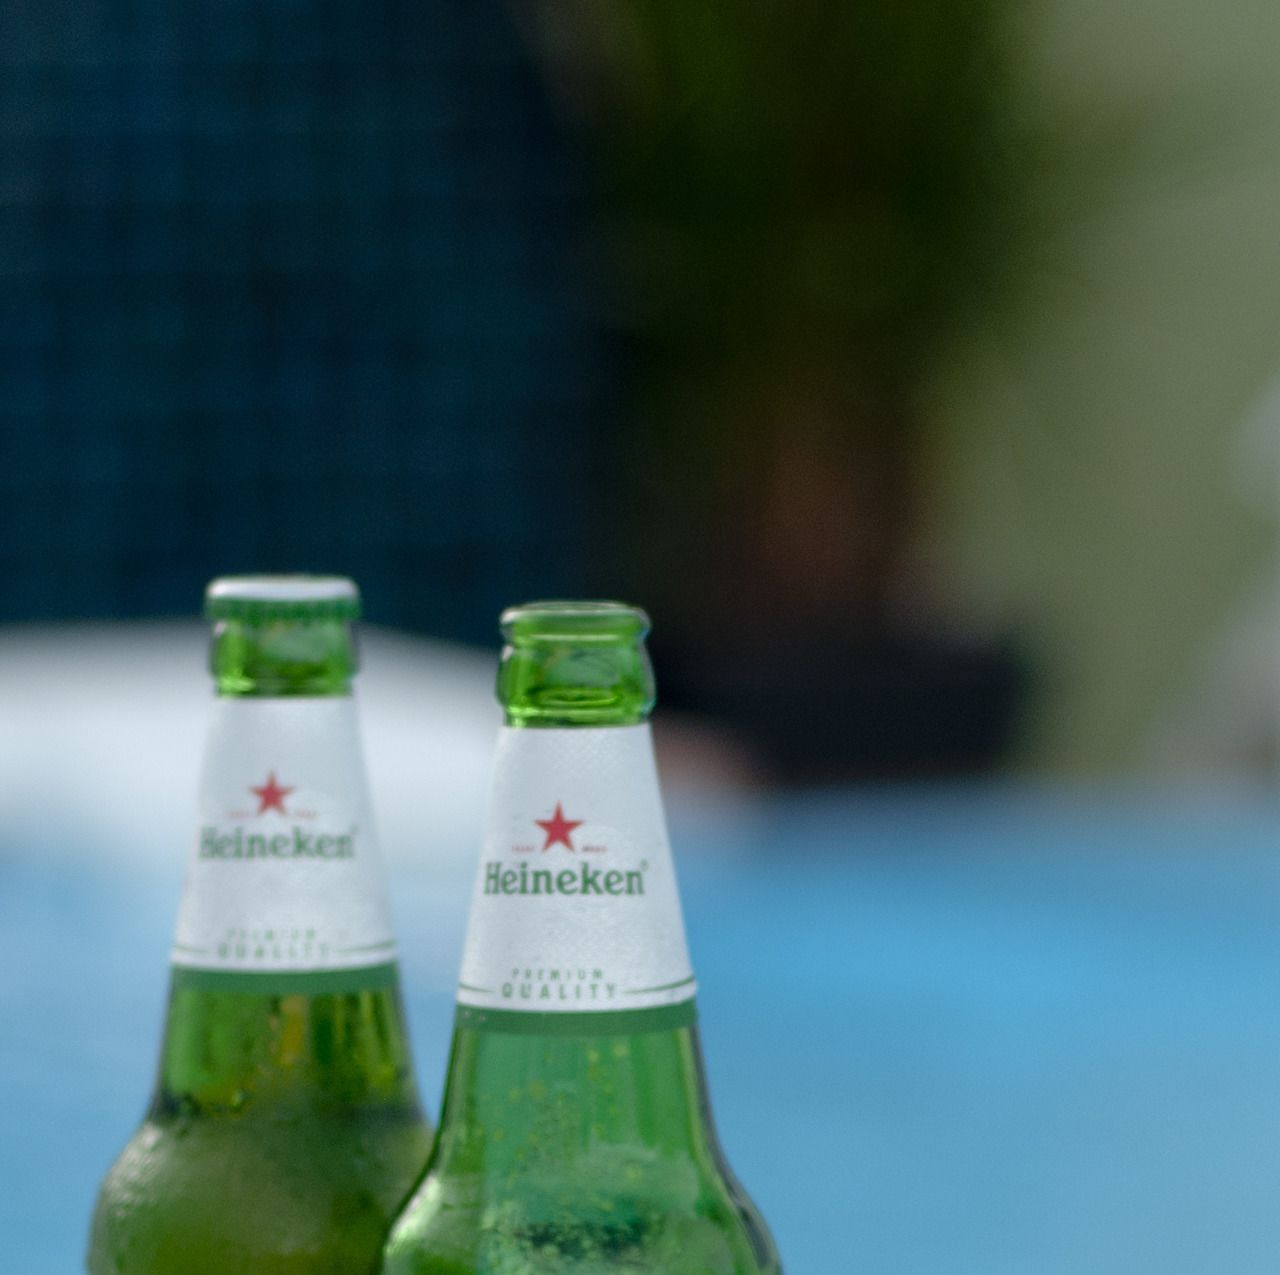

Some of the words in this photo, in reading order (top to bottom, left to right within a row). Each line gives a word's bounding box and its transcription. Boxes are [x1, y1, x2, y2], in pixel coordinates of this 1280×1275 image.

[198, 824, 355, 860] Heineken
[483, 861, 646, 895] Heineken
[511, 967, 604, 980] PREMIUM
[501, 982, 617, 999] QUALITY
